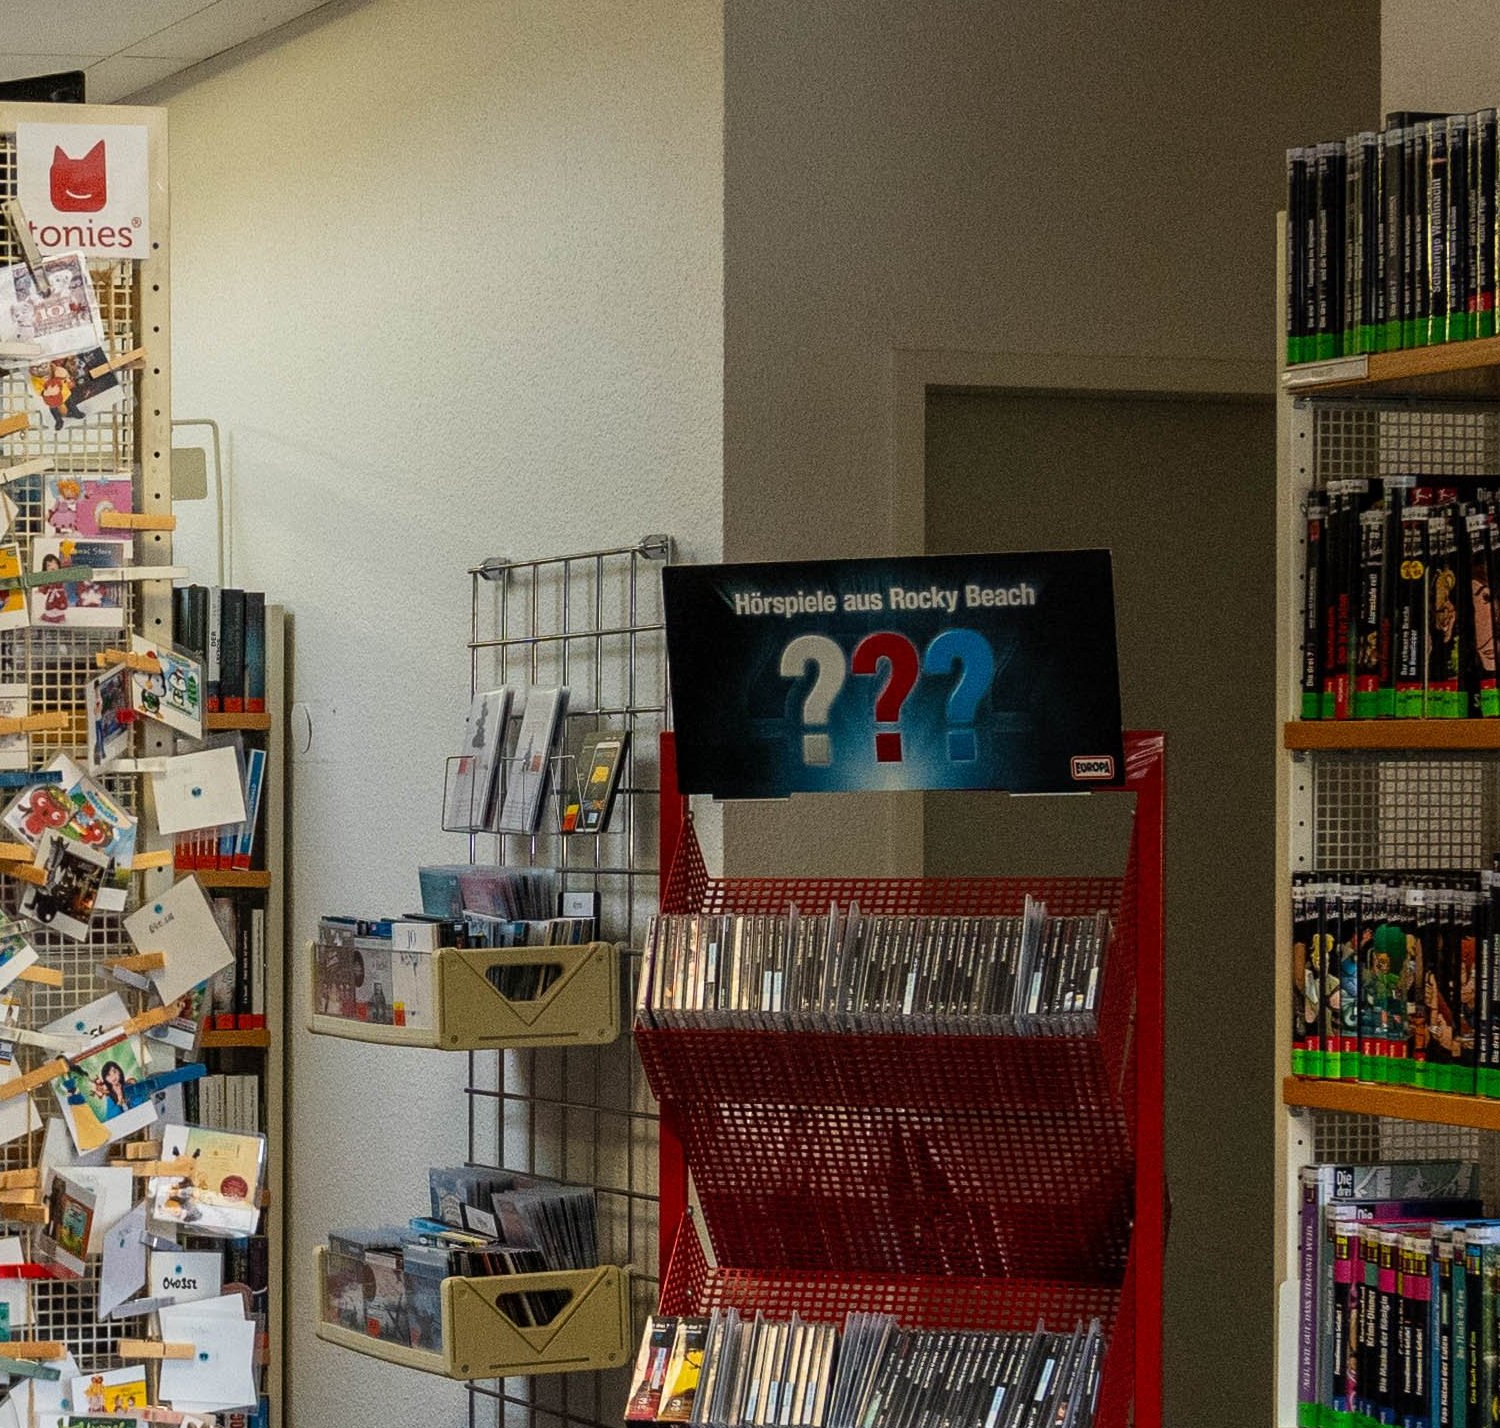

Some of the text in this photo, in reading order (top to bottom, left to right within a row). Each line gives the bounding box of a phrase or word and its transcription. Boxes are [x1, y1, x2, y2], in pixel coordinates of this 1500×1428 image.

[734, 583, 1035, 619] Hörspiele aus Rocky Beach
[1073, 758, 1113, 778] EUROPA
